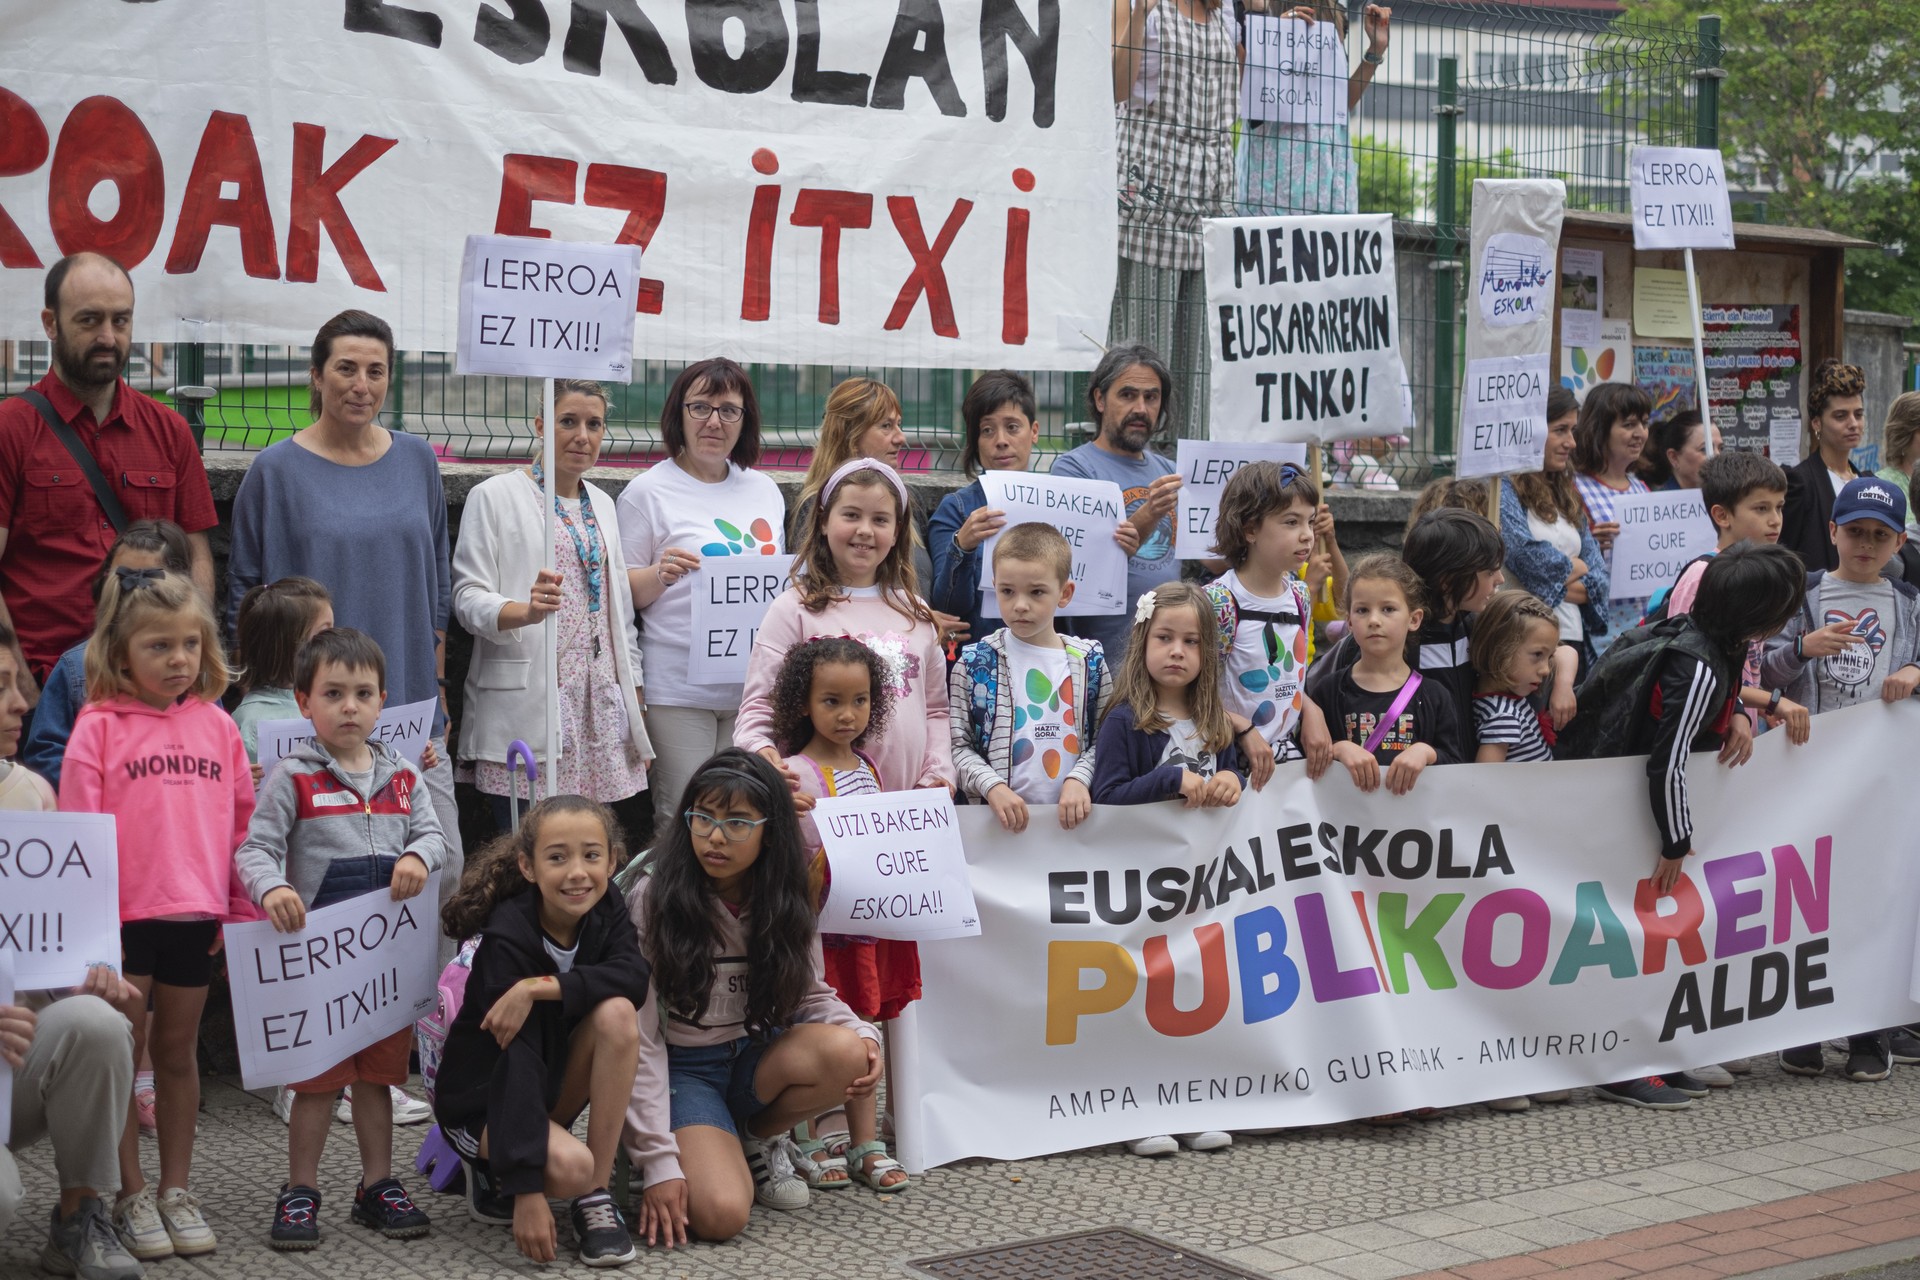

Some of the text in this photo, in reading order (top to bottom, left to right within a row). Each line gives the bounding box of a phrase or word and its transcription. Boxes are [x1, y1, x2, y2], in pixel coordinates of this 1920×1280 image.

[1279, 60, 1318, 78] GURE
[1642, 163, 1718, 186] LERROA
[1644, 203, 1715, 227] EZ ITXI!!
[494, 153, 668, 315] EZ
[1233, 226, 1383, 289] MENDIKO
[483, 257, 622, 299] LERROA
[1494, 295, 1534, 316] ESKOLA
[480, 314, 601, 353] EZ ITXI!!
[1218, 294, 1391, 362] EUSKARAREKIN
[1256, 366, 1370, 423] TINKO!
[1478, 372, 1542, 403] LERROA
[1473, 418, 1533, 451] EZ ITXI!!
[1004, 483, 1119, 520] UTZI BAKEAN
[1624, 503, 1707, 525] UTZI BAKEAN
[1188, 507, 1211, 534] EZ
[1648, 532, 1687, 551] GURE
[1630, 560, 1688, 581] ESKOLA
[708, 629, 739, 657] EZ
[1832, 653, 1869, 670] WINNER
[125, 754, 222, 782] WONDER
[828, 806, 950, 839] UTZI BAKEAN
[876, 850, 930, 877] GURE
[1048, 822, 1515, 924] EUSKAL ESKOLA
[850, 890, 944, 920] ESKOLA!!
[254, 903, 418, 985] LERROA
[1046, 835, 1833, 1046] PUBLIKOAREN
[1659, 937, 1834, 1043] ALDE
[262, 967, 399, 1053] EZ ITXI!!
[1049, 1087, 1139, 1120] AMPA
[1157, 1067, 1311, 1107] MENDIKO
